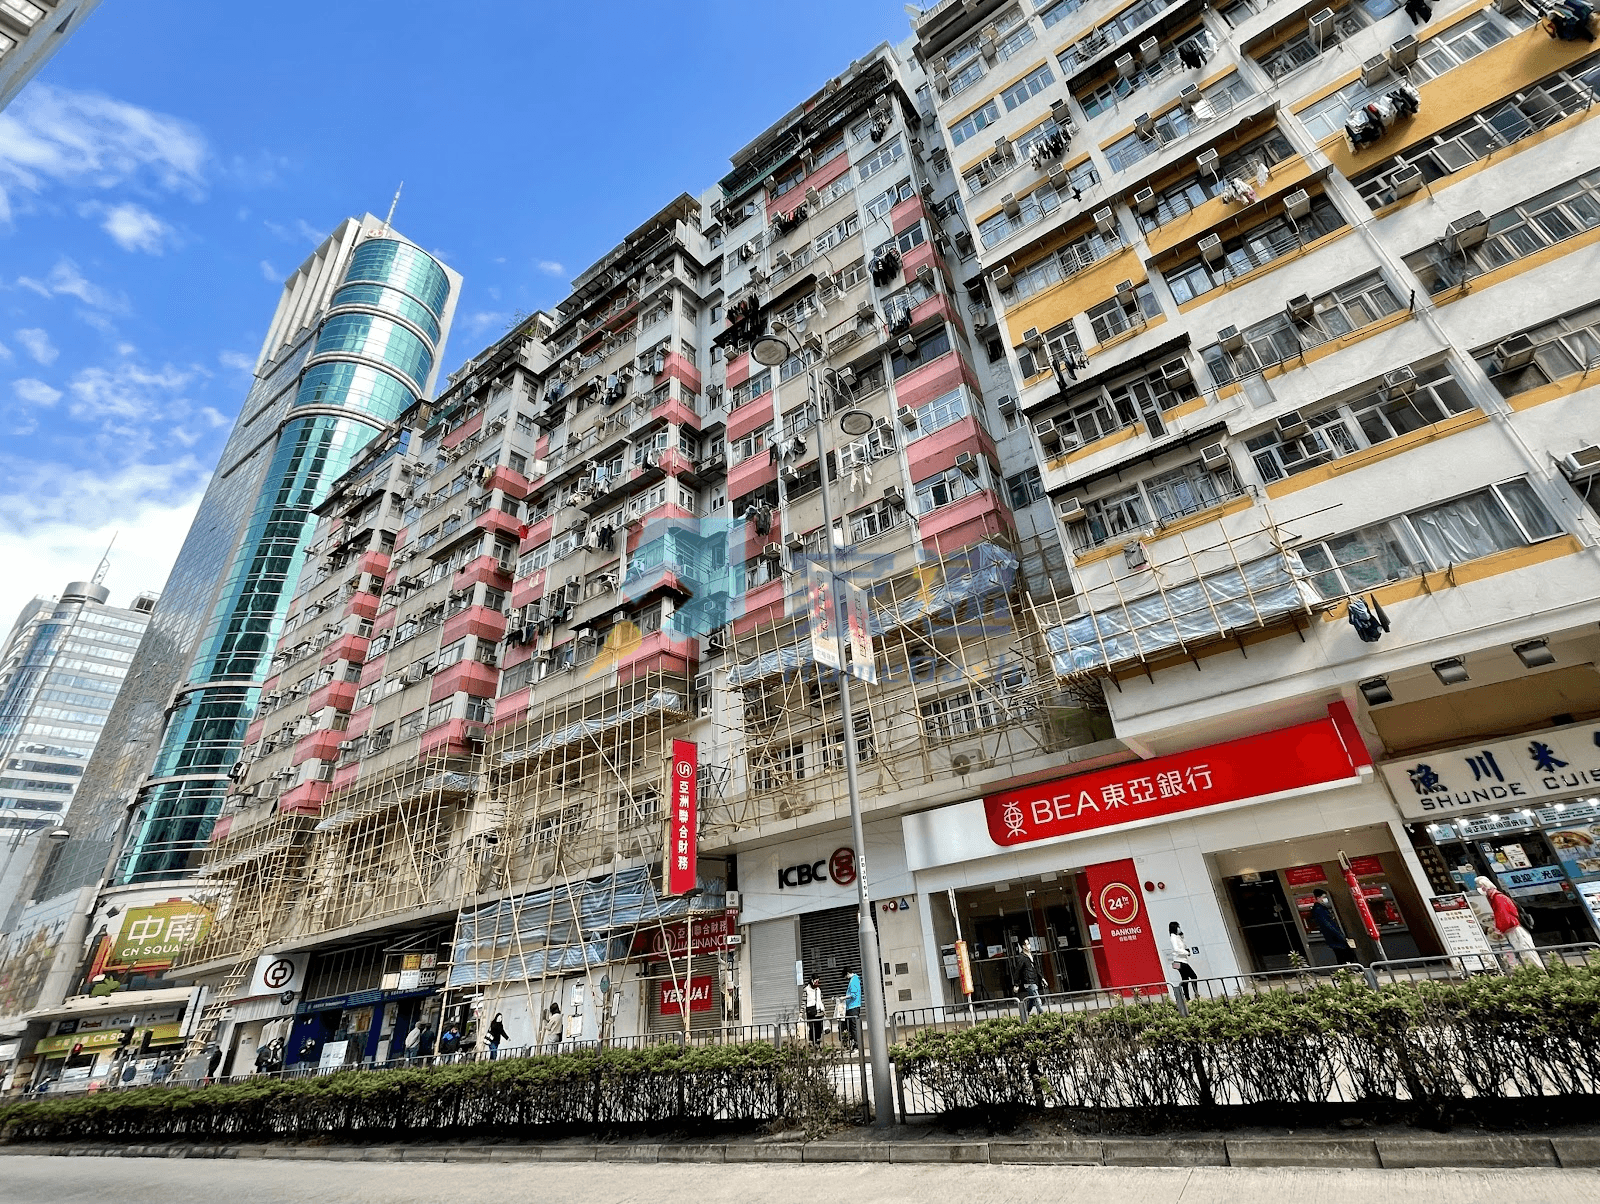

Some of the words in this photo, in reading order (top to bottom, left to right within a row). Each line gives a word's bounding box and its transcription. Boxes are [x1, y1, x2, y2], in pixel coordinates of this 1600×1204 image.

[1030, 790, 1101, 825] BEA
[1100, 763, 1213, 810] 東亞銀行
[1420, 782, 1527, 811] SHUNDE
[677, 780, 690, 871] 亞洲聯合財務
[777, 859, 827, 889] ICBC
[127, 912, 206, 946] 中南
[1111, 926, 1142, 937] BANKING
[122, 947, 140, 957] CN
